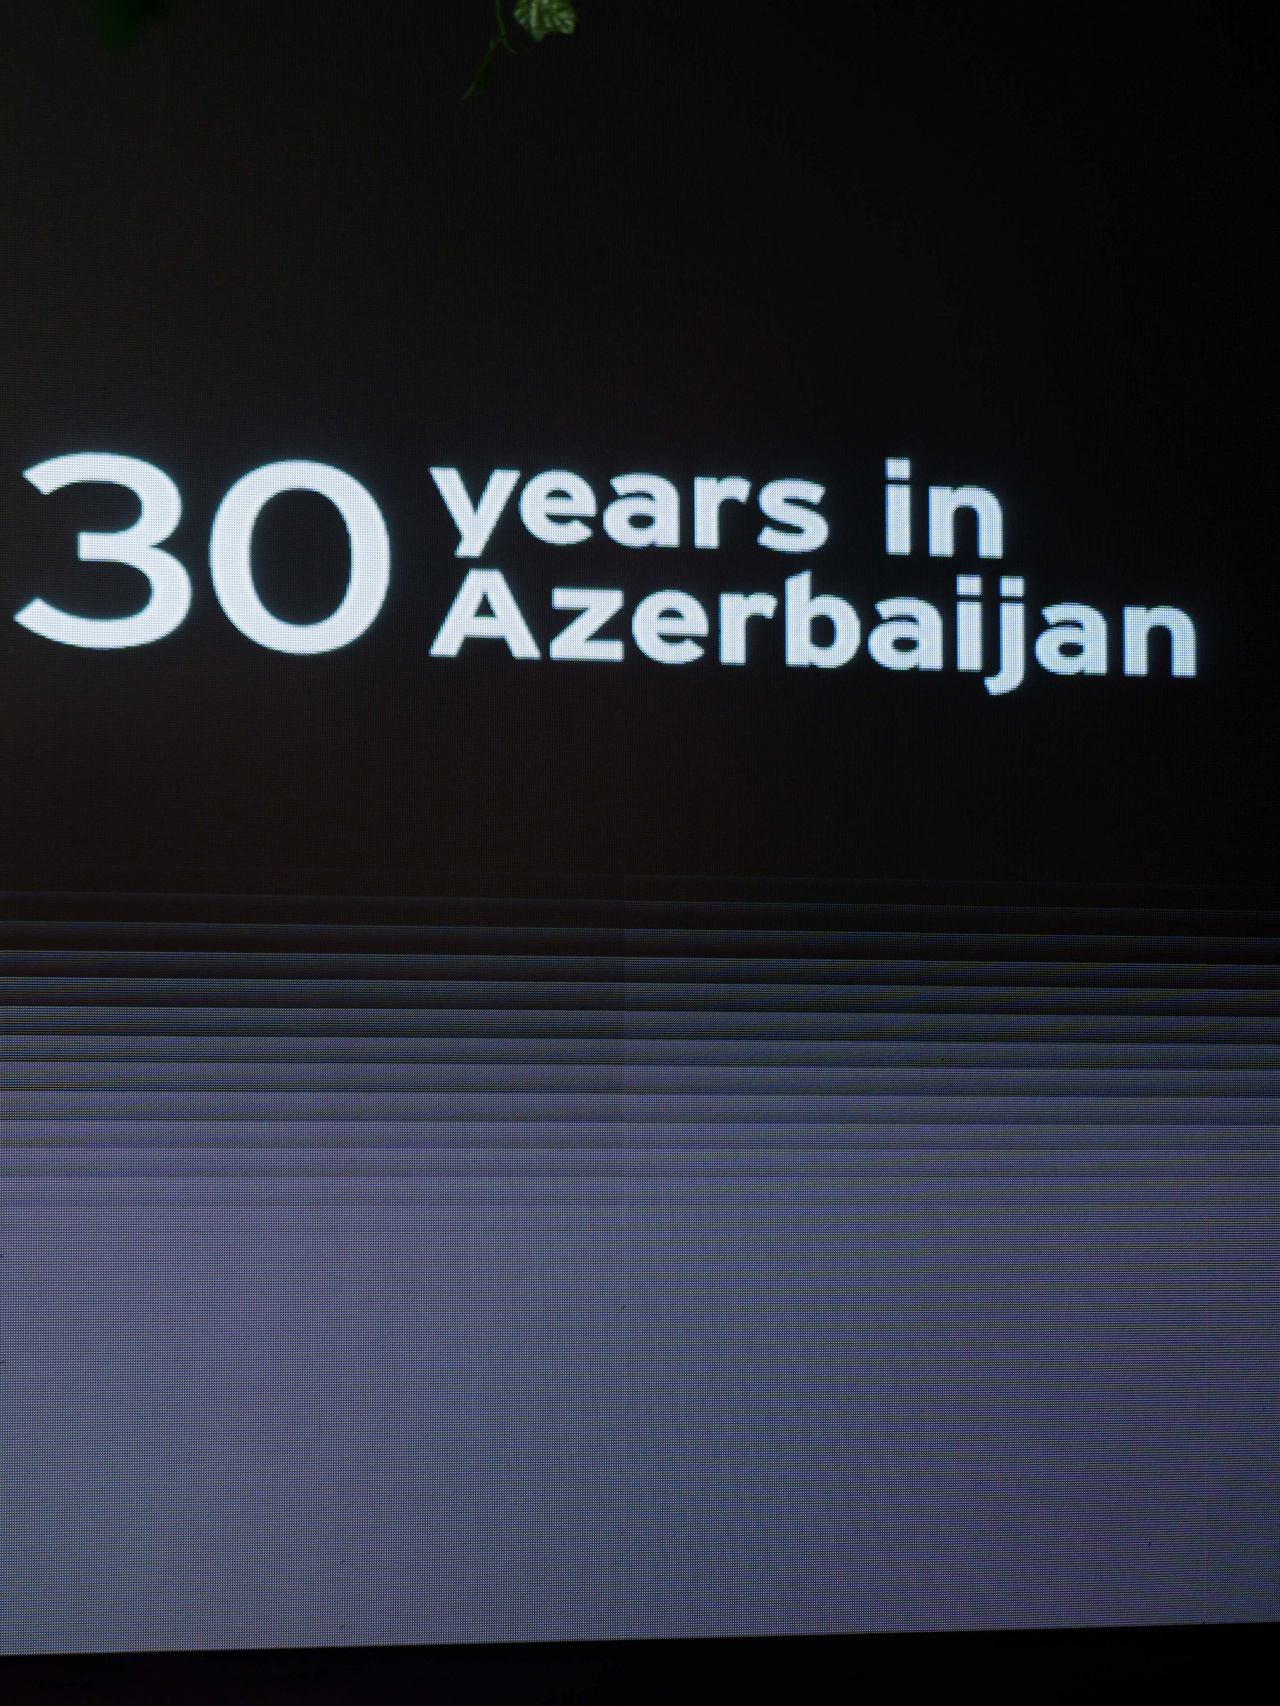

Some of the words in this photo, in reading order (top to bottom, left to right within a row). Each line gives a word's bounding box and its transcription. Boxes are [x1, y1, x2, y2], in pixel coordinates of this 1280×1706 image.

[15, 452, 391, 656] 30
[429, 466, 829, 559] years
[885, 458, 1005, 560] in
[430, 568, 1197, 696] Azerbaijan
